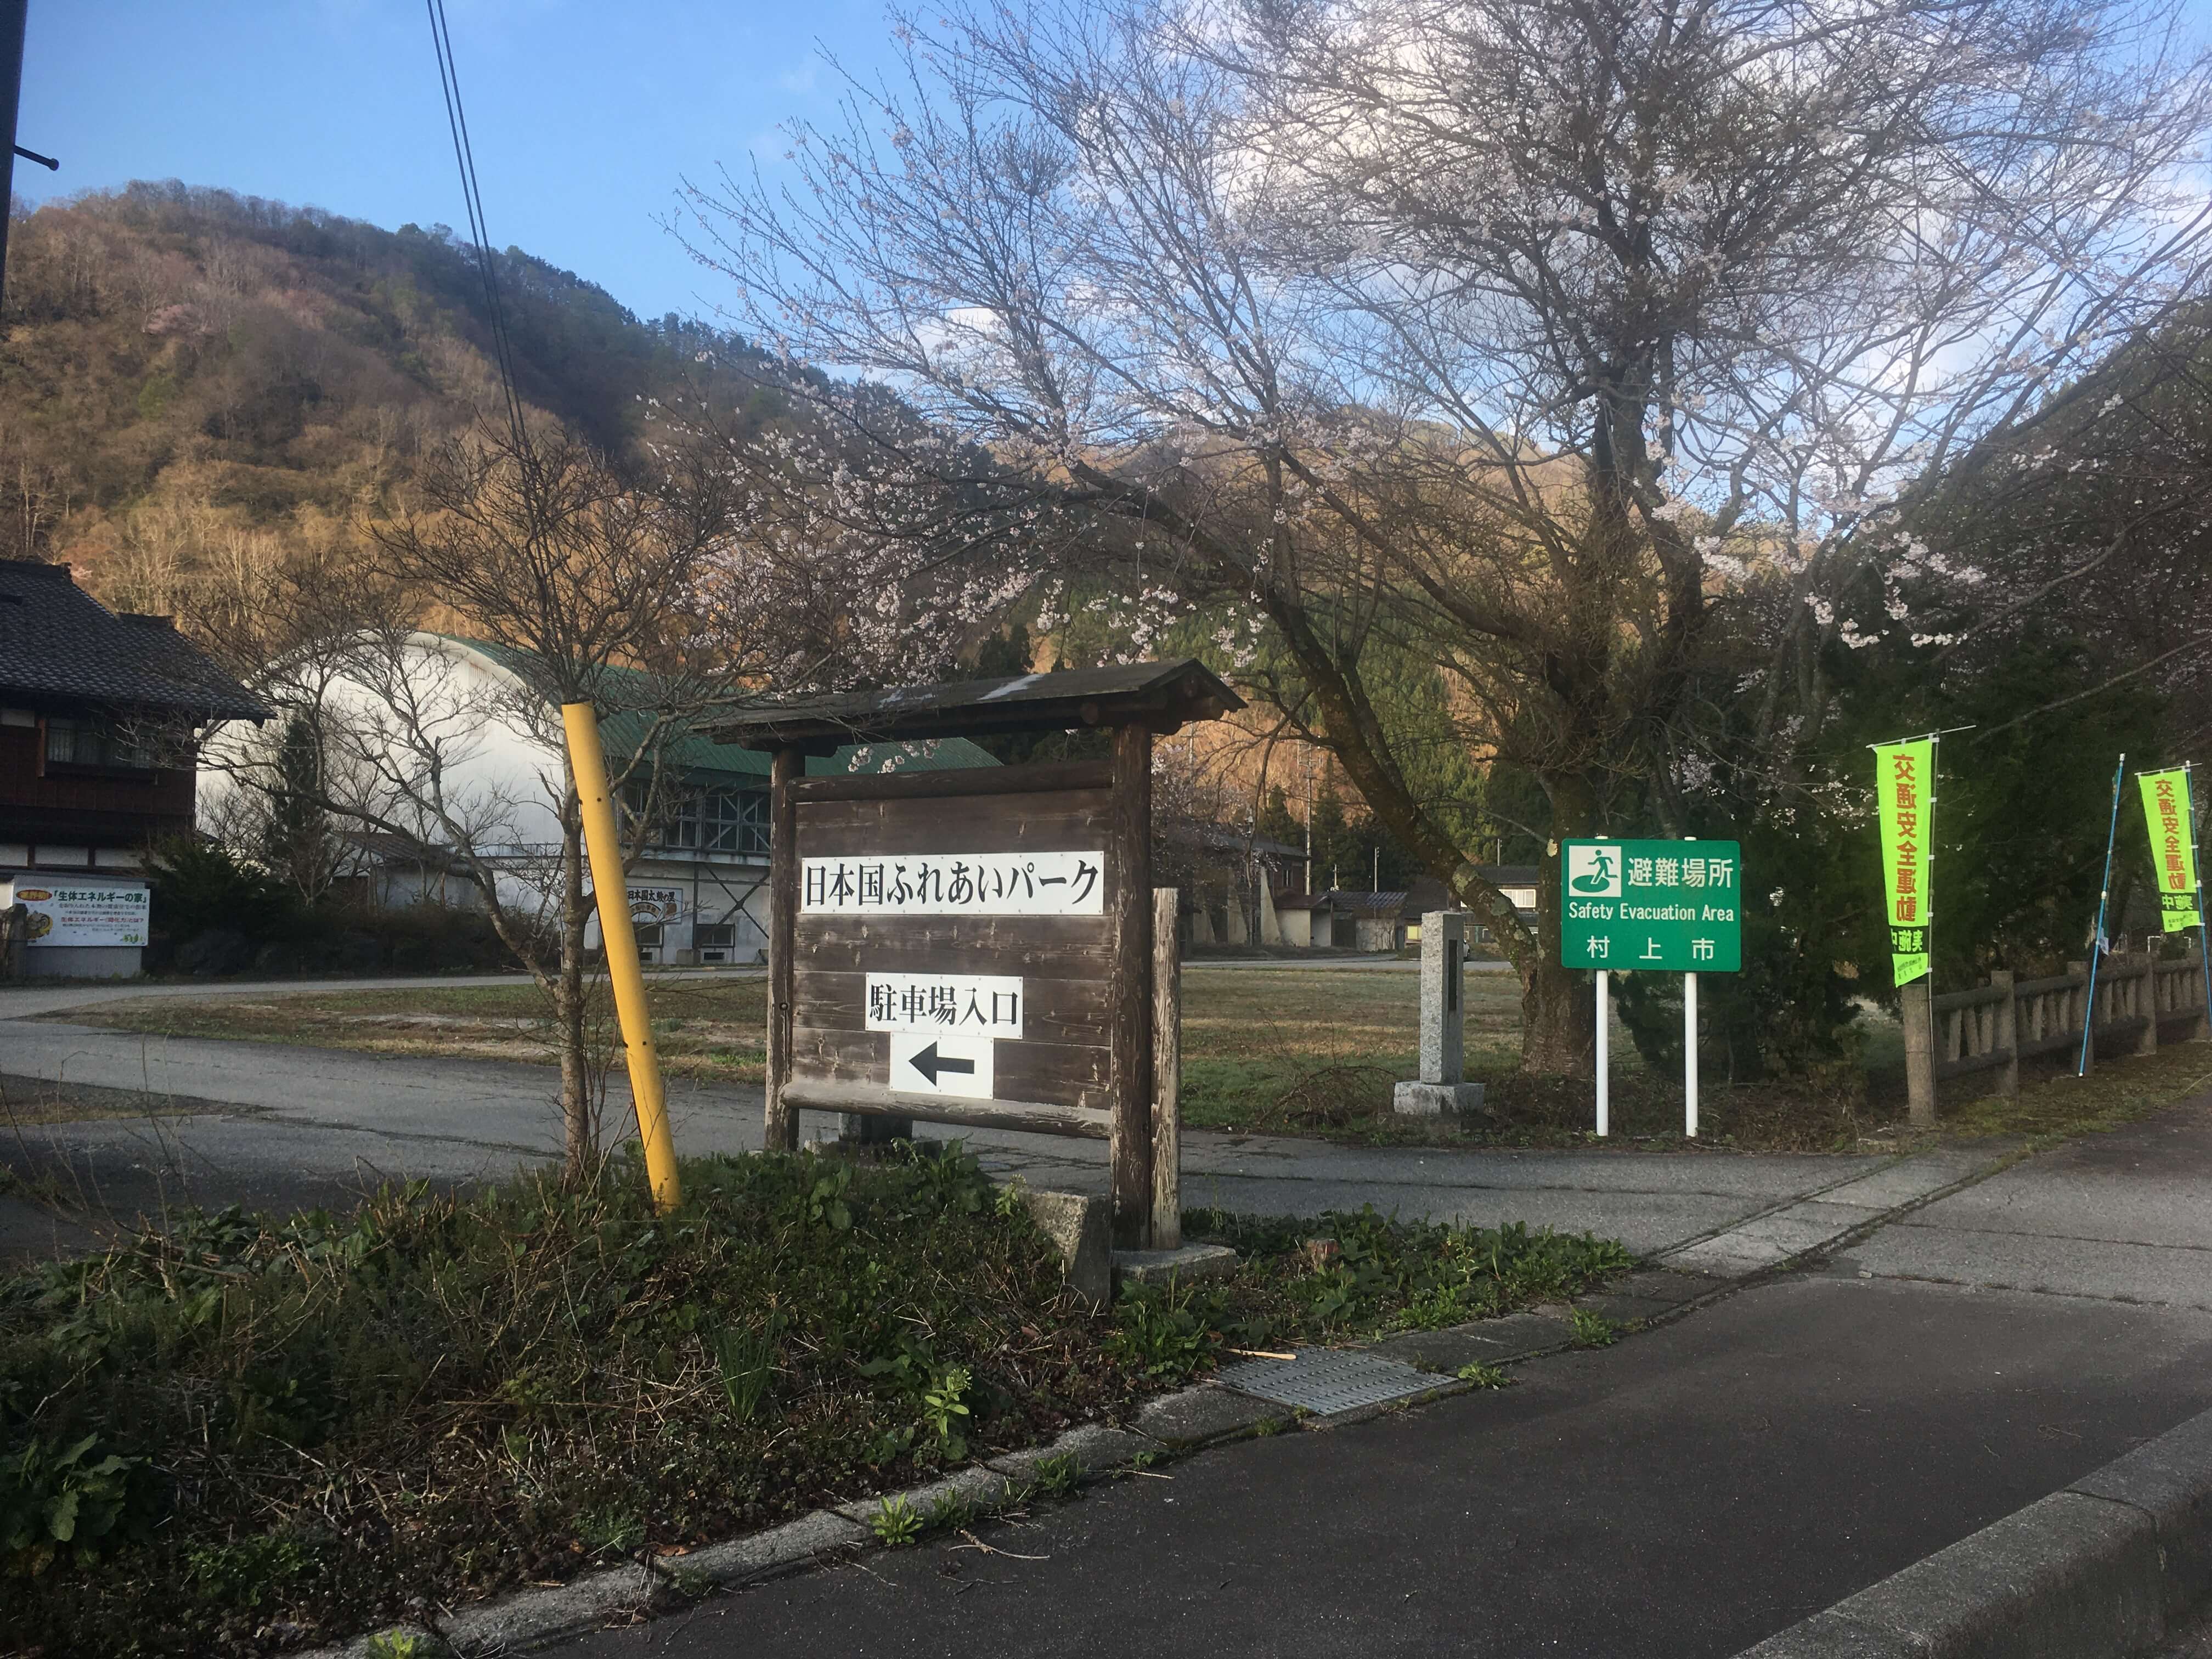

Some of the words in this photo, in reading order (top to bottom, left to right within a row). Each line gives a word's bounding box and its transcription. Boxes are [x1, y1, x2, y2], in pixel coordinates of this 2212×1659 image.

[806, 860, 1098, 906] 日本国ふれあいパーク
[1628, 857, 1734, 888] 避難場所
[1568, 902, 1613, 920] Safety
[1620, 903, 1696, 921] Evacuation
[1702, 905, 1734, 922] Area
[1587, 935, 1715, 961] 村上市
[870, 984, 1018, 1026] 駐車場入口
